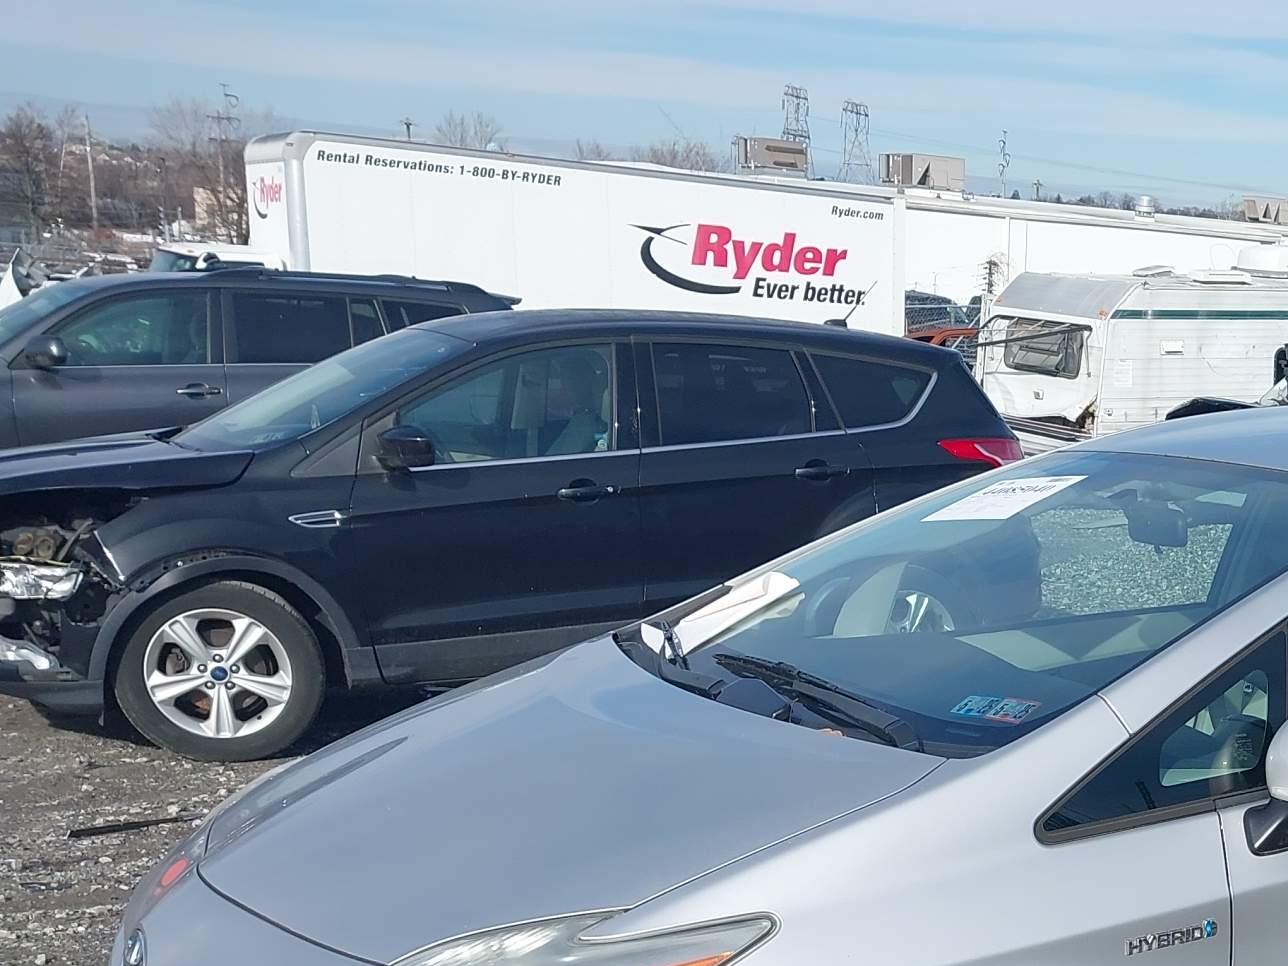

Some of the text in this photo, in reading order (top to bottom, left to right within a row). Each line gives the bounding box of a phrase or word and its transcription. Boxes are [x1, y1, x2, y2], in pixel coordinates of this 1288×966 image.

[317, 150, 562, 187] Rental Reservations: 1-800-BY-RYDER
[260, 175, 282, 208] Ryder
[831, 205, 884, 221] Ryder.com
[691, 223, 848, 280] Ryder
[752, 277, 865, 305] Ever better.
[1124, 926, 1204, 956] HYBRID
